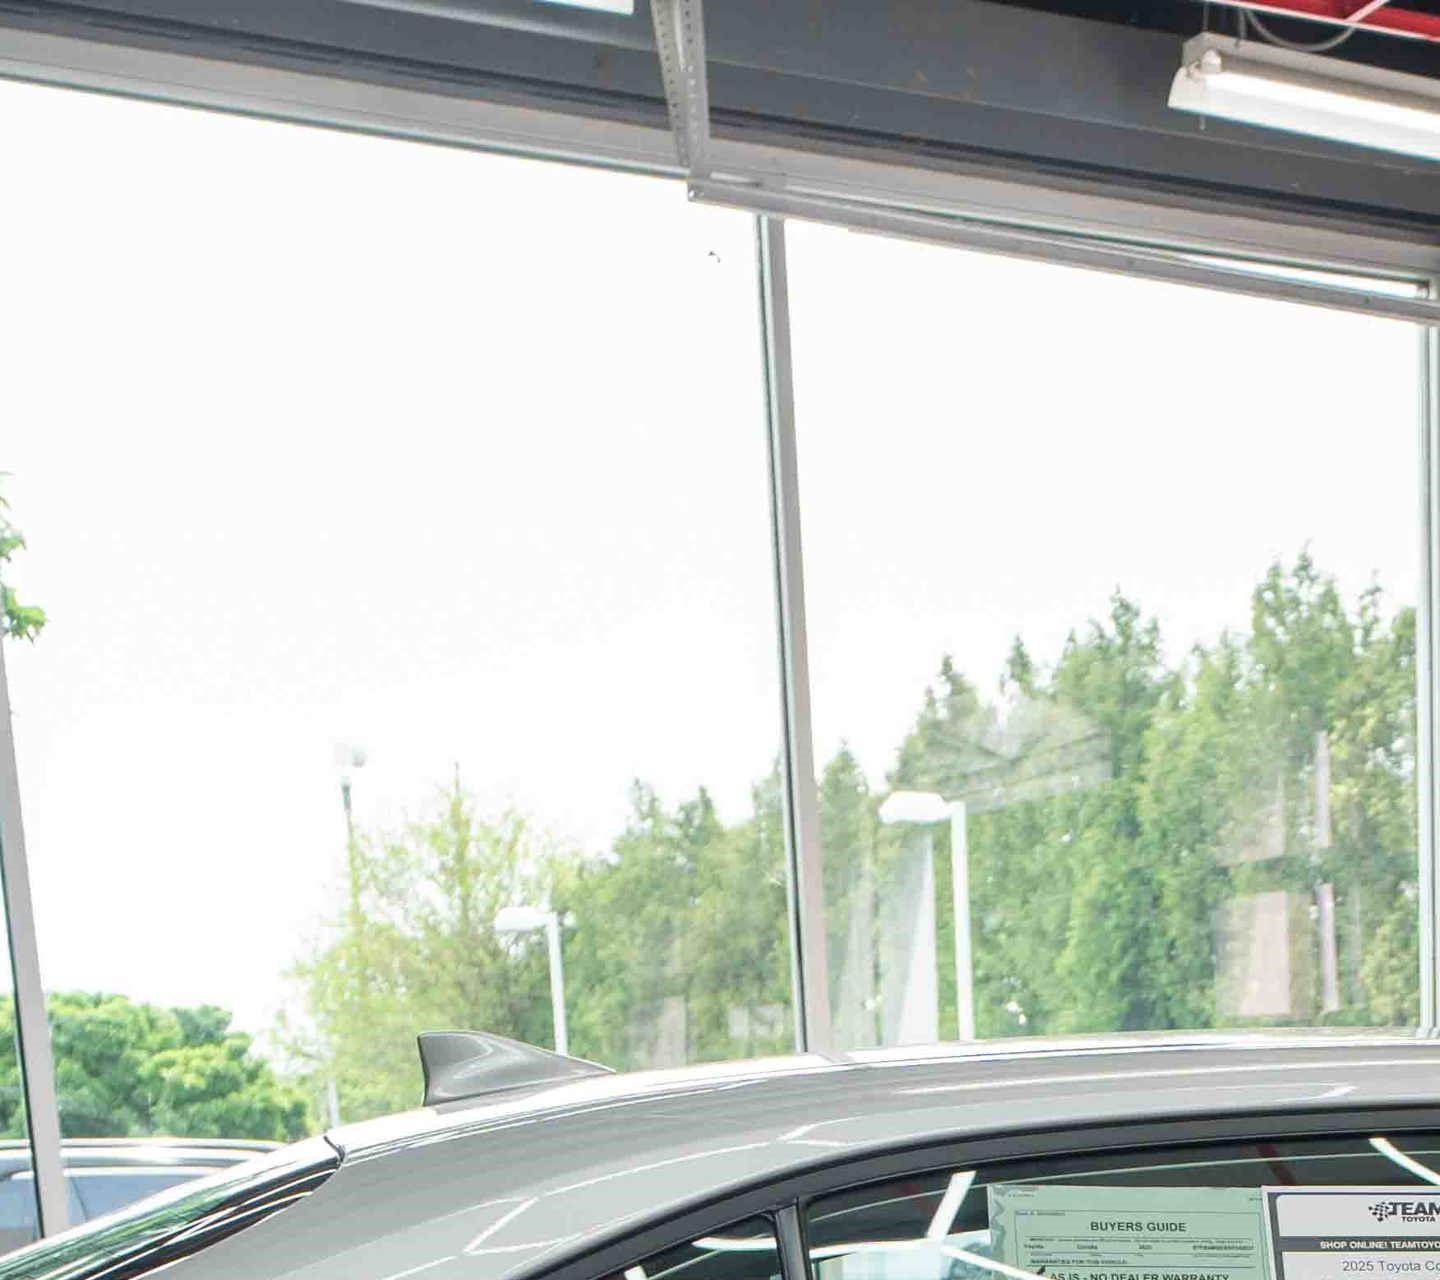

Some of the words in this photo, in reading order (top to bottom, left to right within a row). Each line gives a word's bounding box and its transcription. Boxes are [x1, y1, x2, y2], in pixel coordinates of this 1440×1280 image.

[1090, 1221, 1143, 1232] BUYERS
[1146, 1222, 1187, 1232] GUIDE
[1320, 1240, 1347, 1249] SHOP
[1349, 1241, 1388, 1249] ONLINE!
[1342, 1260, 1374, 1272] 2025
[1378, 1260, 1421, 1274] Toyota
